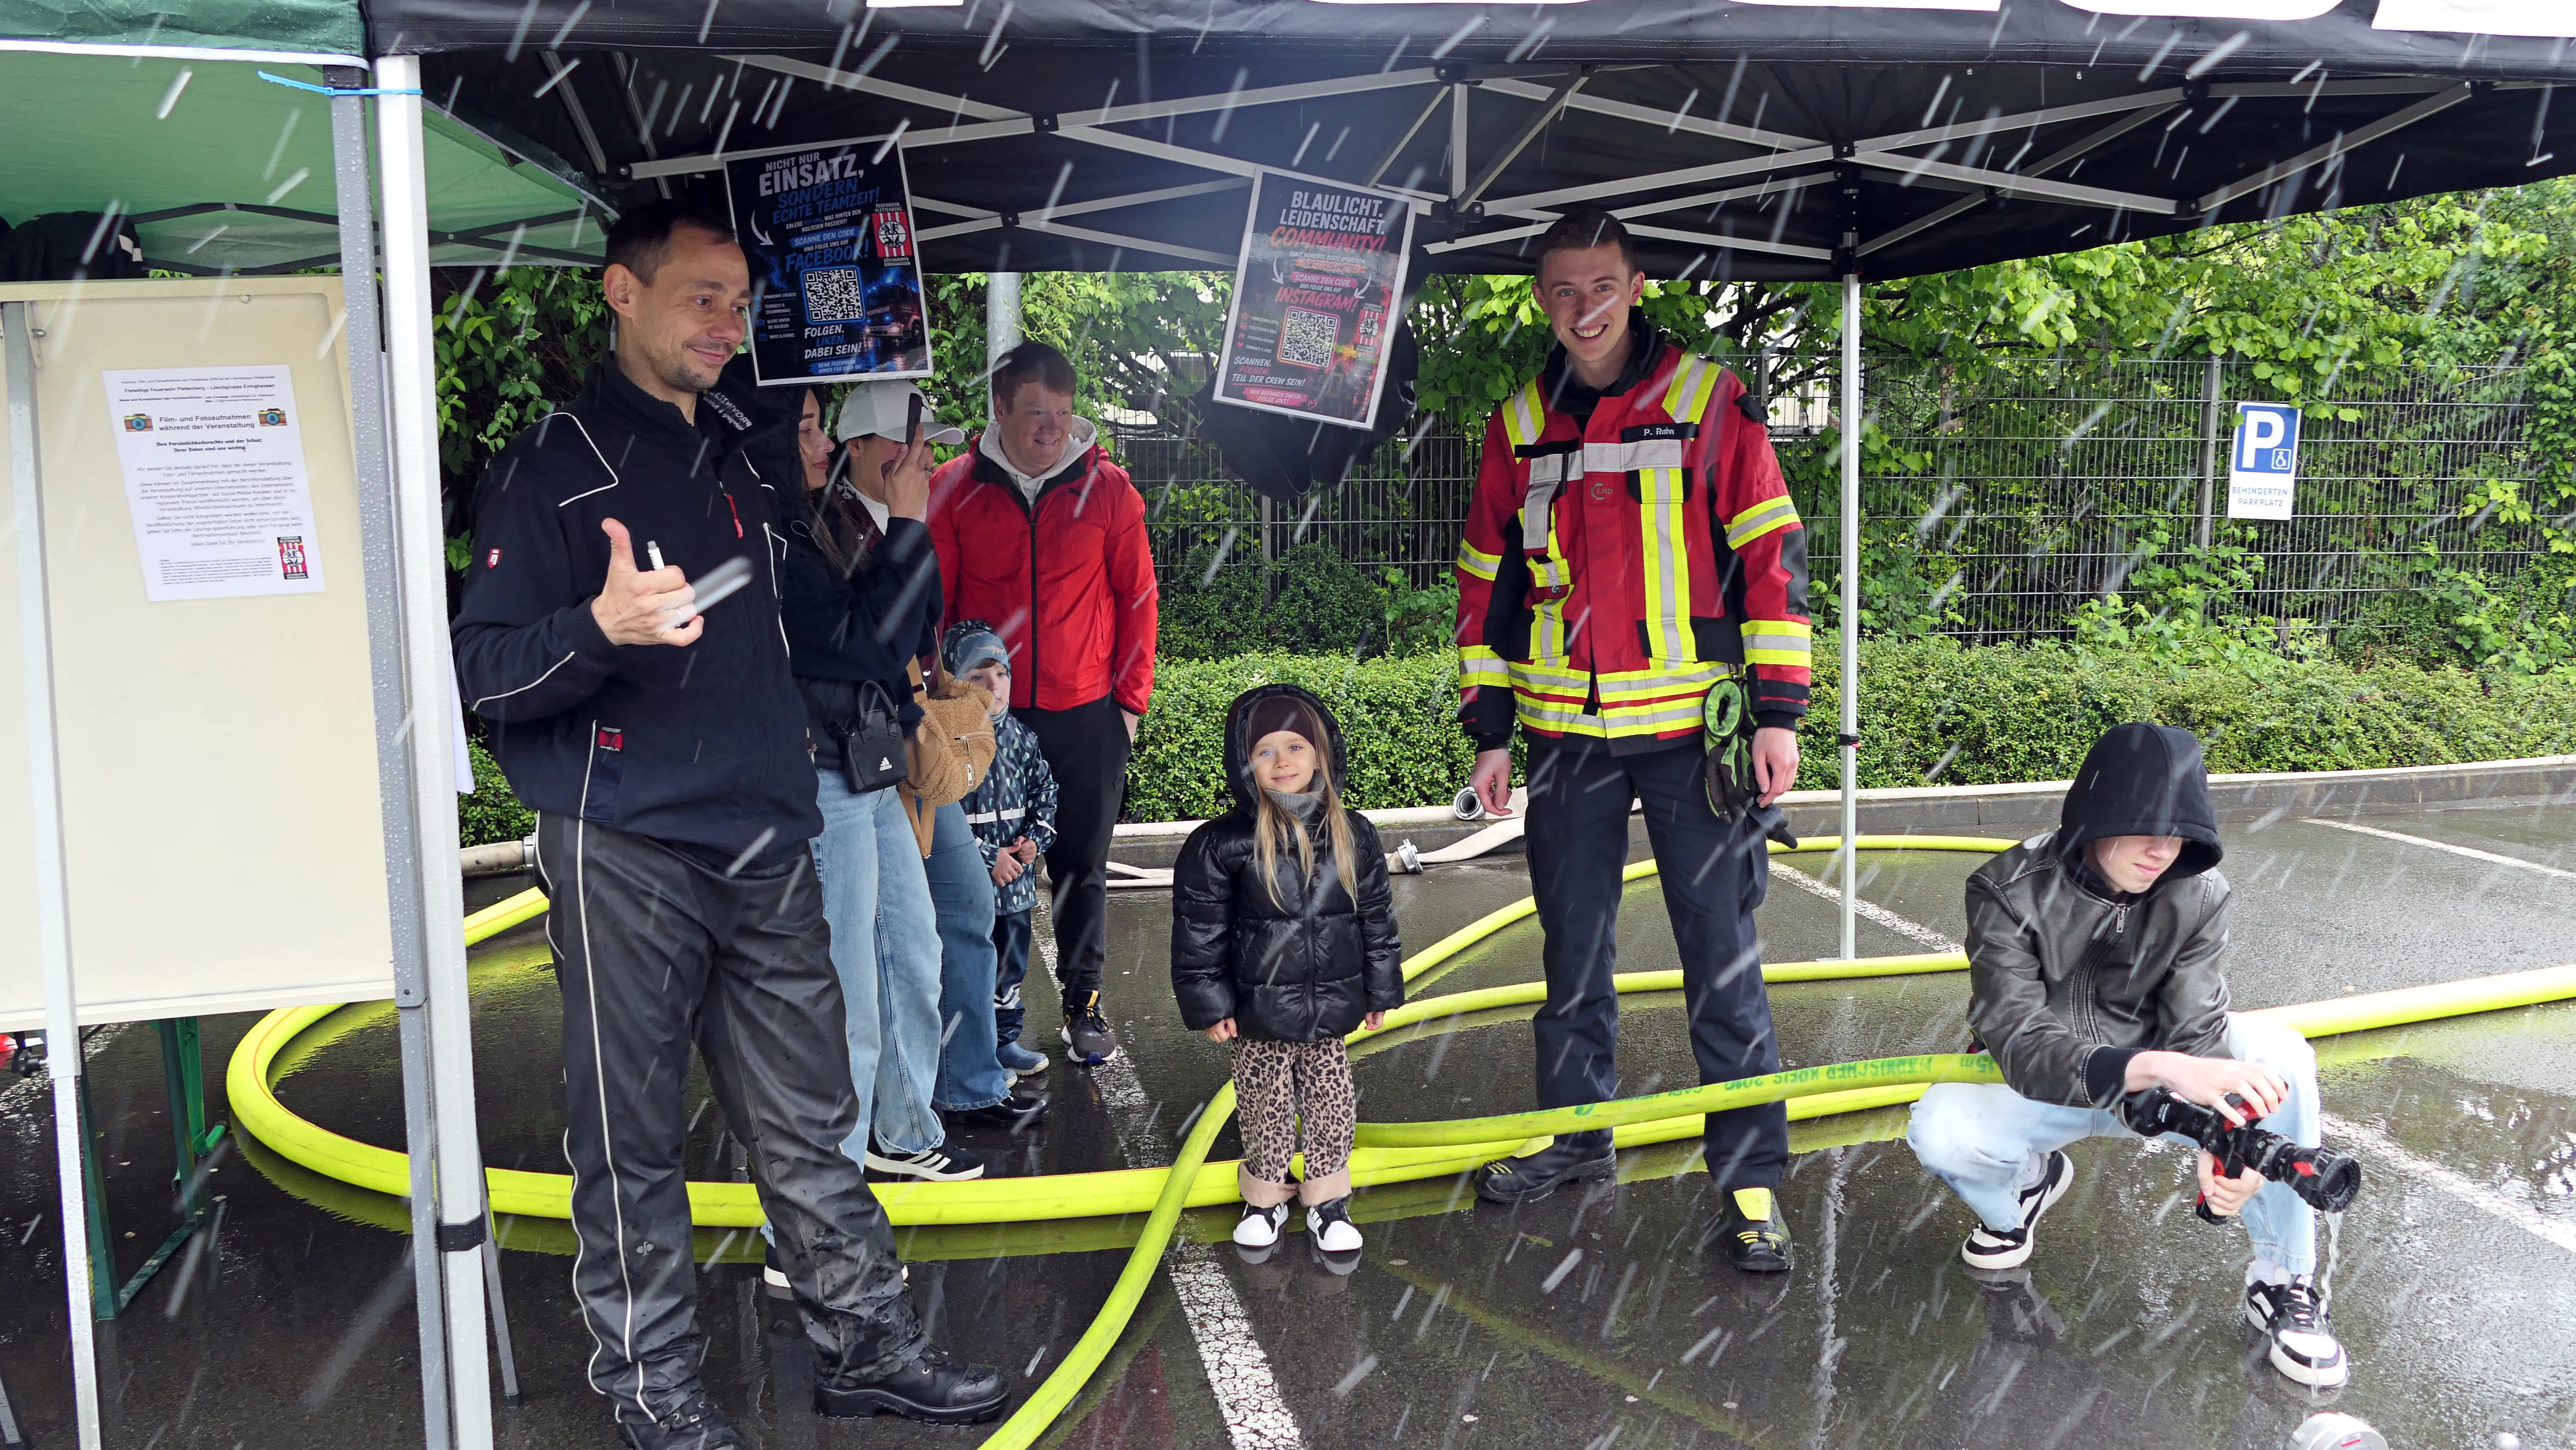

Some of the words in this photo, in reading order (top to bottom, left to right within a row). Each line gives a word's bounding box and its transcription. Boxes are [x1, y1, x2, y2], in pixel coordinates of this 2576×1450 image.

[765, 157, 796, 172] NICHT
[799, 152, 820, 164] NUR
[759, 153, 864, 197] EINSATZ,
[778, 177, 857, 209] SONDERN
[773, 206, 813, 225] ECHTE
[817, 187, 880, 213] TEAMZEIT!
[1291, 191, 1383, 218] BLAULICHT.
[786, 221, 803, 229] ERLEBE
[802, 224, 824, 232] KULISSEN
[825, 218, 847, 227] PASSIERT!
[1280, 209, 1385, 235] LEIDENSCHAFT.
[795, 234, 821, 246] SCANNE
[838, 228, 855, 237] CODE
[1270, 226, 1386, 256] COMMUNITY!
[1295, 274, 1320, 283] SCANNE
[1275, 286, 1360, 312] INSTAGRAM!
[805, 324, 844, 338] FOLGEN.
[816, 335, 846, 346] LIKEN.
[805, 346, 833, 359] DABEI
[836, 342, 862, 355] SEIN!
[1234, 356, 1271, 367] SCANNEN.
[1239, 366, 1269, 375] FOLGEN.
[1232, 374, 1246, 382] TEIL
[1265, 377, 1285, 385] CREW
[1286, 378, 1306, 386] SEIN!
[2242, 410, 2285, 468] P
[2232, 486, 2291, 496] BEHINDERTEN-
[2238, 498, 2283, 506] PARKPLATZ
